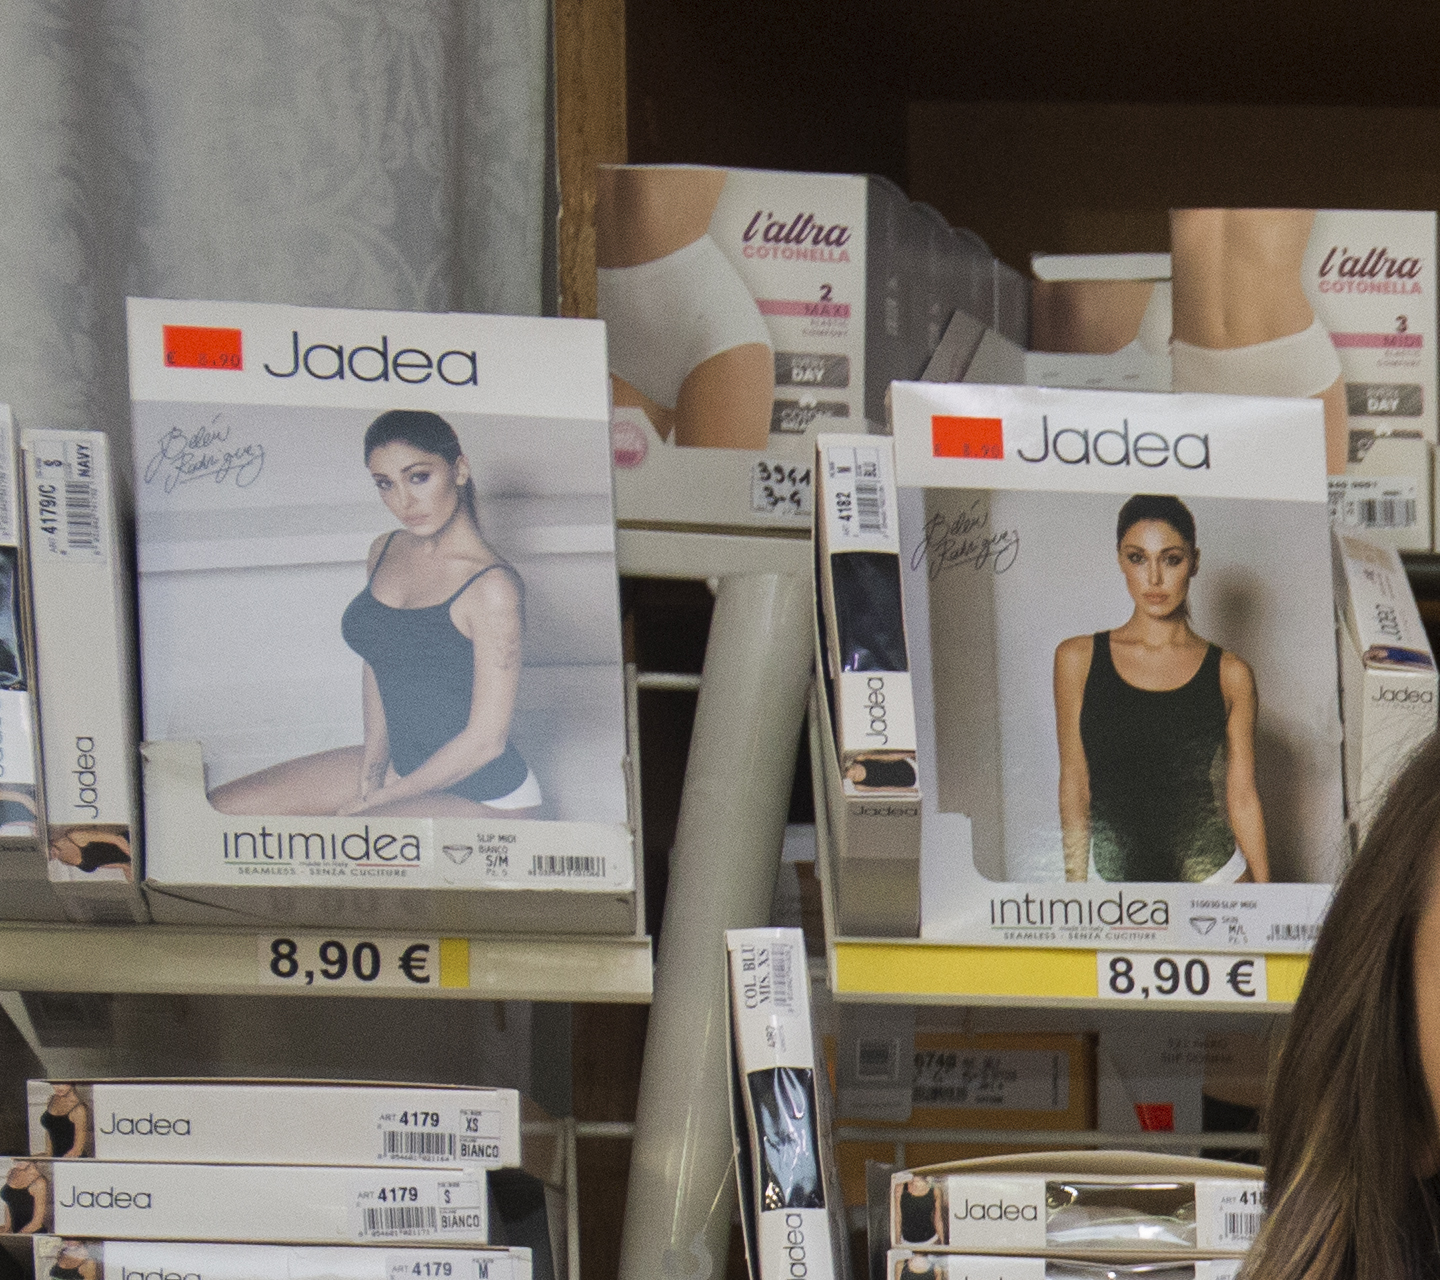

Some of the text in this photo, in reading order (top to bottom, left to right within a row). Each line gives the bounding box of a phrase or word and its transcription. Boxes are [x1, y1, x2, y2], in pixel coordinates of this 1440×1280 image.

[742, 210, 853, 248] l'altra
[742, 244, 851, 263] COTONELLA
[1318, 246, 1423, 280] l'altra
[1318, 280, 1422, 295] COTONELLA
[263, 331, 479, 387] Jadea
[1017, 415, 1211, 469] Jadea
[76, 444, 91, 477] NAVY
[39, 484, 58, 535] 4179/C
[865, 677, 889, 744] Jadea
[74, 737, 98, 819] Jadea
[223, 825, 421, 862] intimidea
[990, 891, 1169, 926] intimidea
[269, 938, 430, 984] 8,90 €
[1109, 957, 1256, 999] 8,90 €
[100, 1113, 191, 1136] Jadea
[399, 1111, 440, 1127] 4179
[460, 1144, 499, 1157] BIANCO
[60, 1187, 152, 1209] Jadea
[377, 1187, 418, 1202] 4179
[954, 1199, 1038, 1221] Jadea
[441, 1215, 480, 1228] BIANCO
[411, 1262, 452, 1276] 4179
